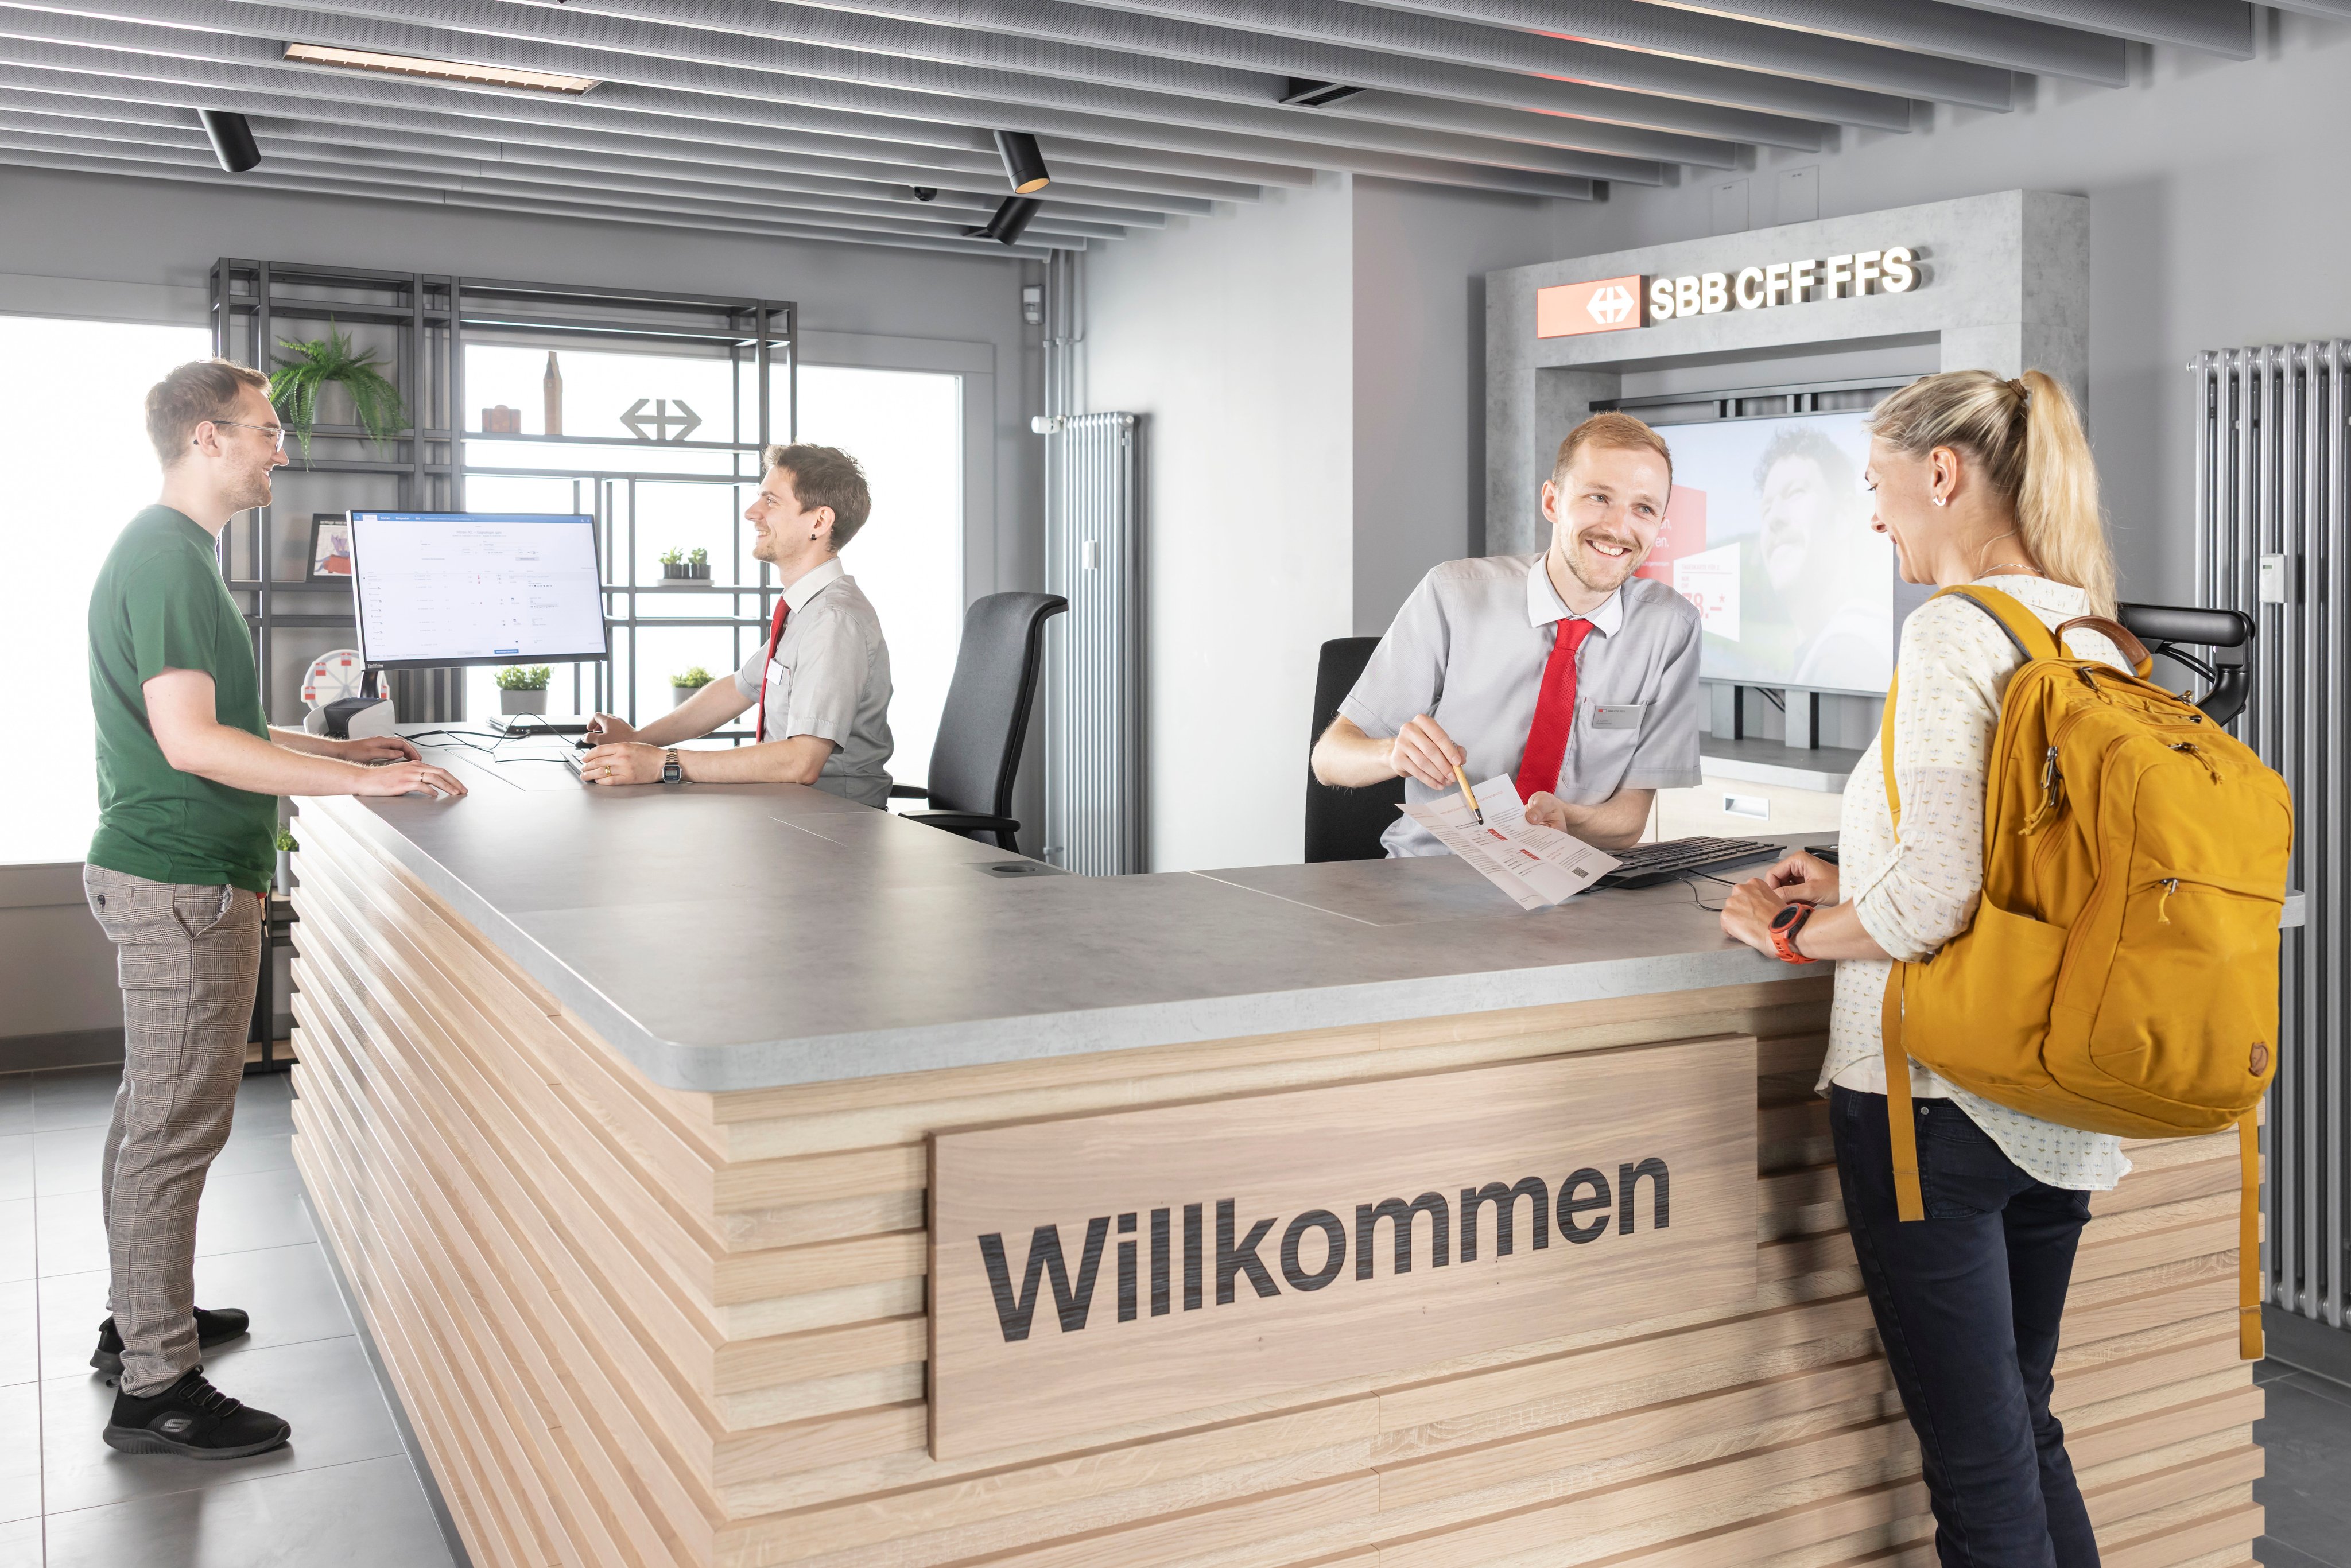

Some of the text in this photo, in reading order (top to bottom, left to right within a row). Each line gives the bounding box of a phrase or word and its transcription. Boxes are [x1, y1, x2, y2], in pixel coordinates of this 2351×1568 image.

[1650, 246, 1914, 320] SBB CFF FFS
[978, 1157, 1670, 1343] Willkommen
